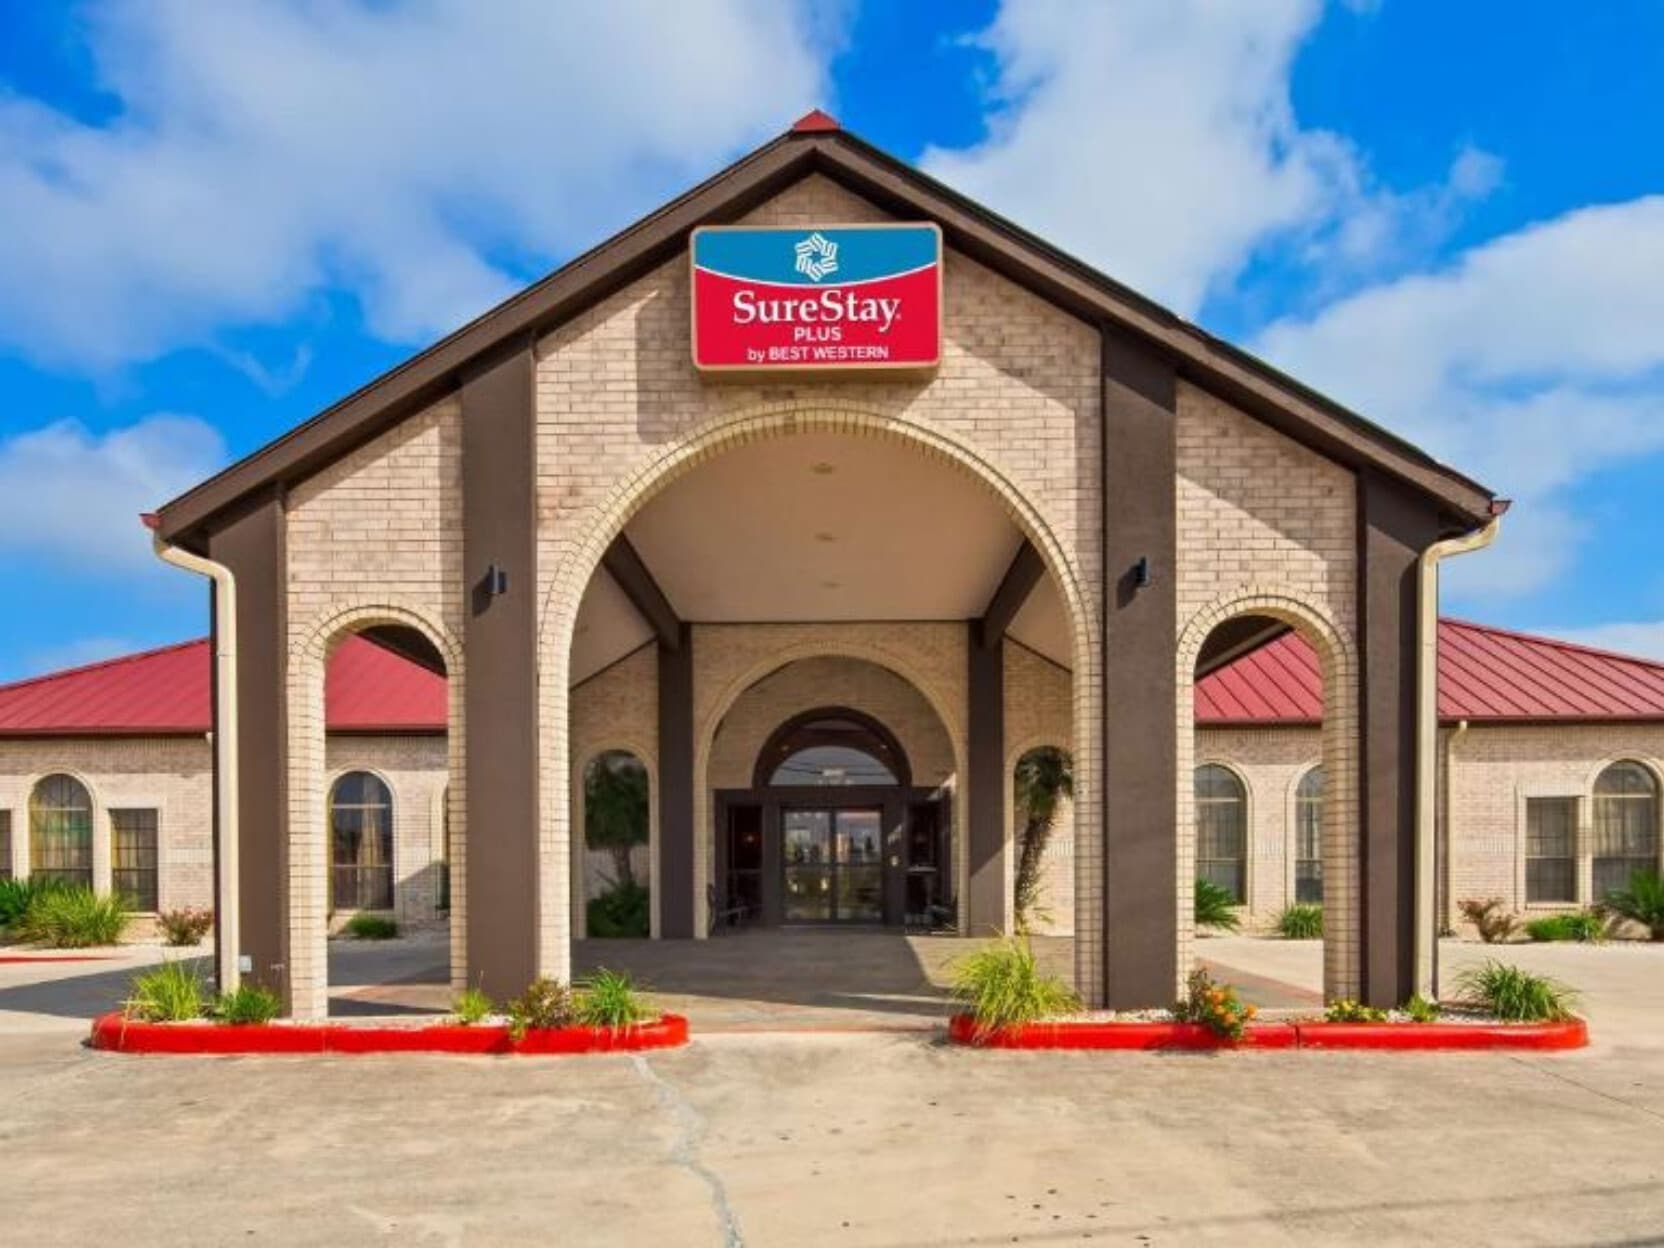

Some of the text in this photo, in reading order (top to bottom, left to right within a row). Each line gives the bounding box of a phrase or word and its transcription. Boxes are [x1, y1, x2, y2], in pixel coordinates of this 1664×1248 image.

[733, 289, 900, 332] SureStay
[794, 326, 842, 341] PLUS
[747, 346, 889, 362] by BEST WESTERN
